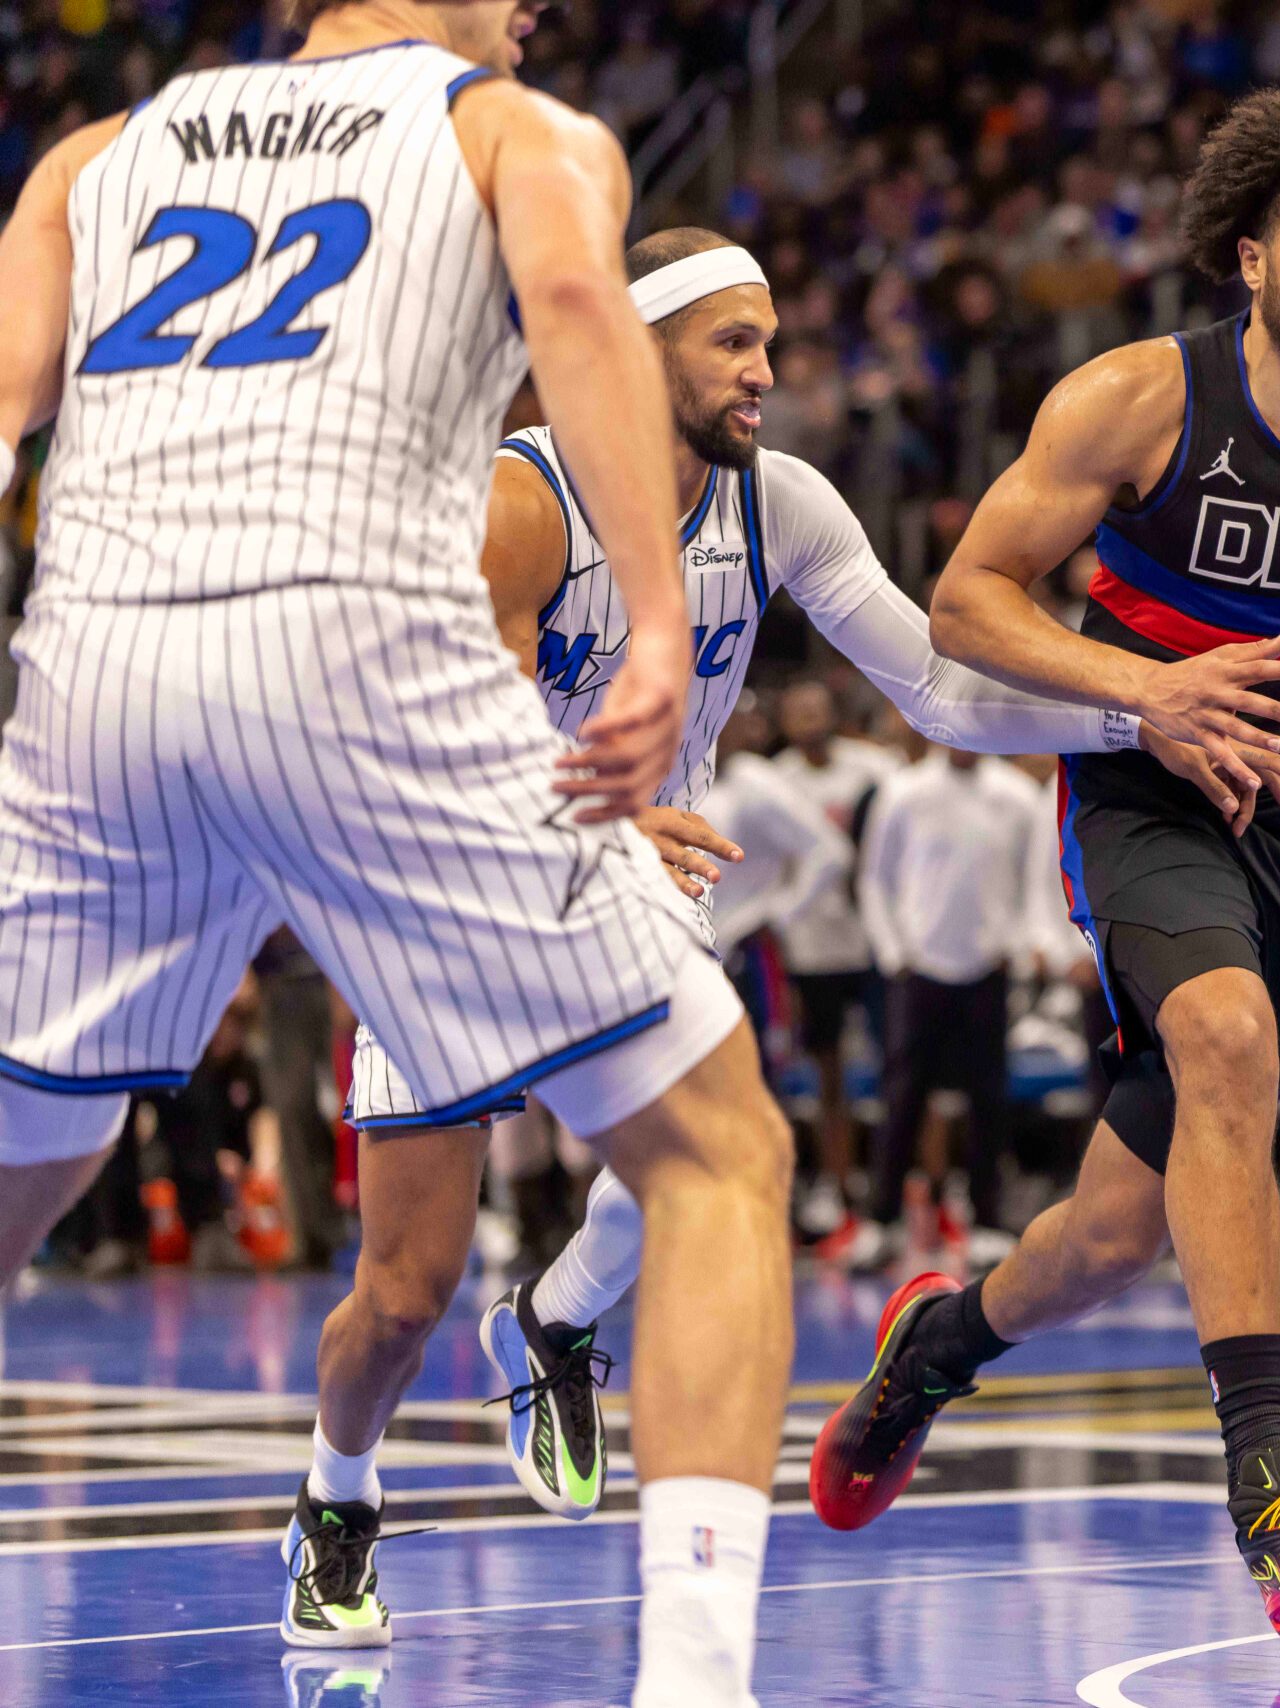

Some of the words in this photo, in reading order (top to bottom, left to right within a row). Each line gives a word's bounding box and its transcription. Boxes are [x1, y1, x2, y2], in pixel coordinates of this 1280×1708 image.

[168, 101, 386, 165] WAGNER
[76, 198, 372, 376] 22
[690, 546, 744, 569] Disney
